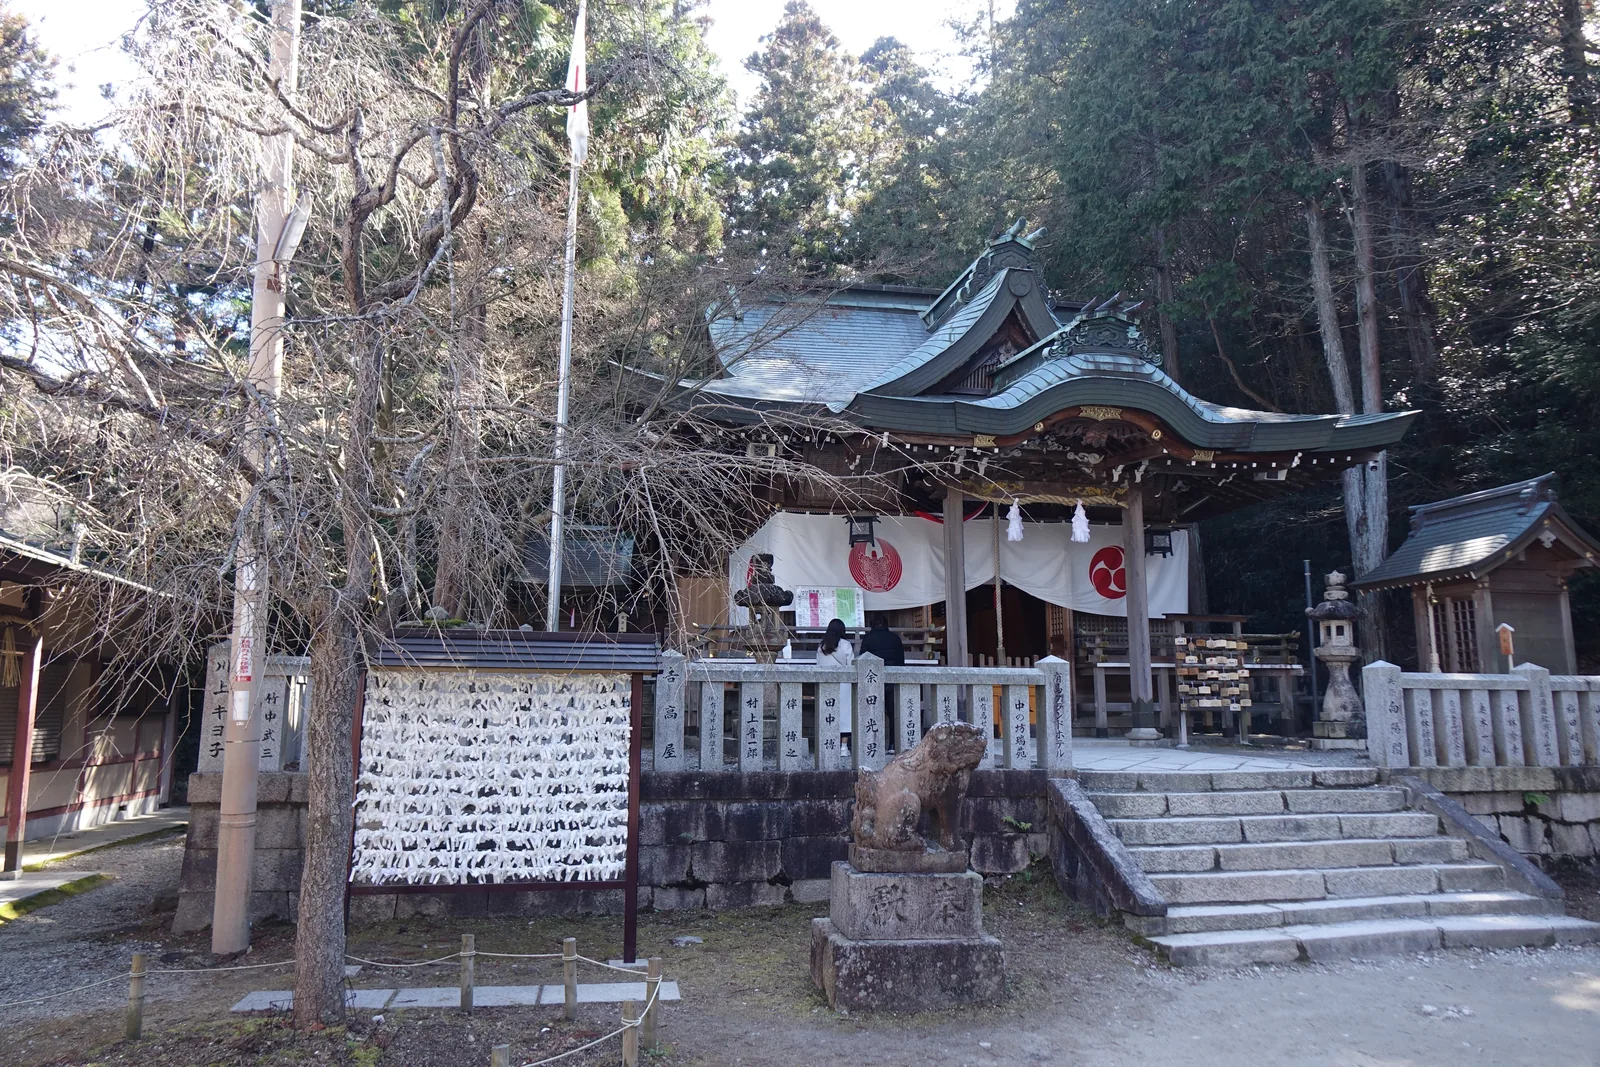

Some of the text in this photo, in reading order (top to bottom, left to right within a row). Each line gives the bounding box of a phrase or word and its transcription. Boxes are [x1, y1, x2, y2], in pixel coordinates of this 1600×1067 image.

[209, 661, 230, 758] 川上キヨ子
[260, 691, 280, 759] 竹中武三
[746, 697, 760, 759] 村上晋一郎
[824, 698, 837, 751] 田中博
[865, 669, 879, 759] 余田光男
[1014, 700, 1027, 761] 中の坊瑞苑
[1053, 672, 1065, 758] 有馬グランドホテル
